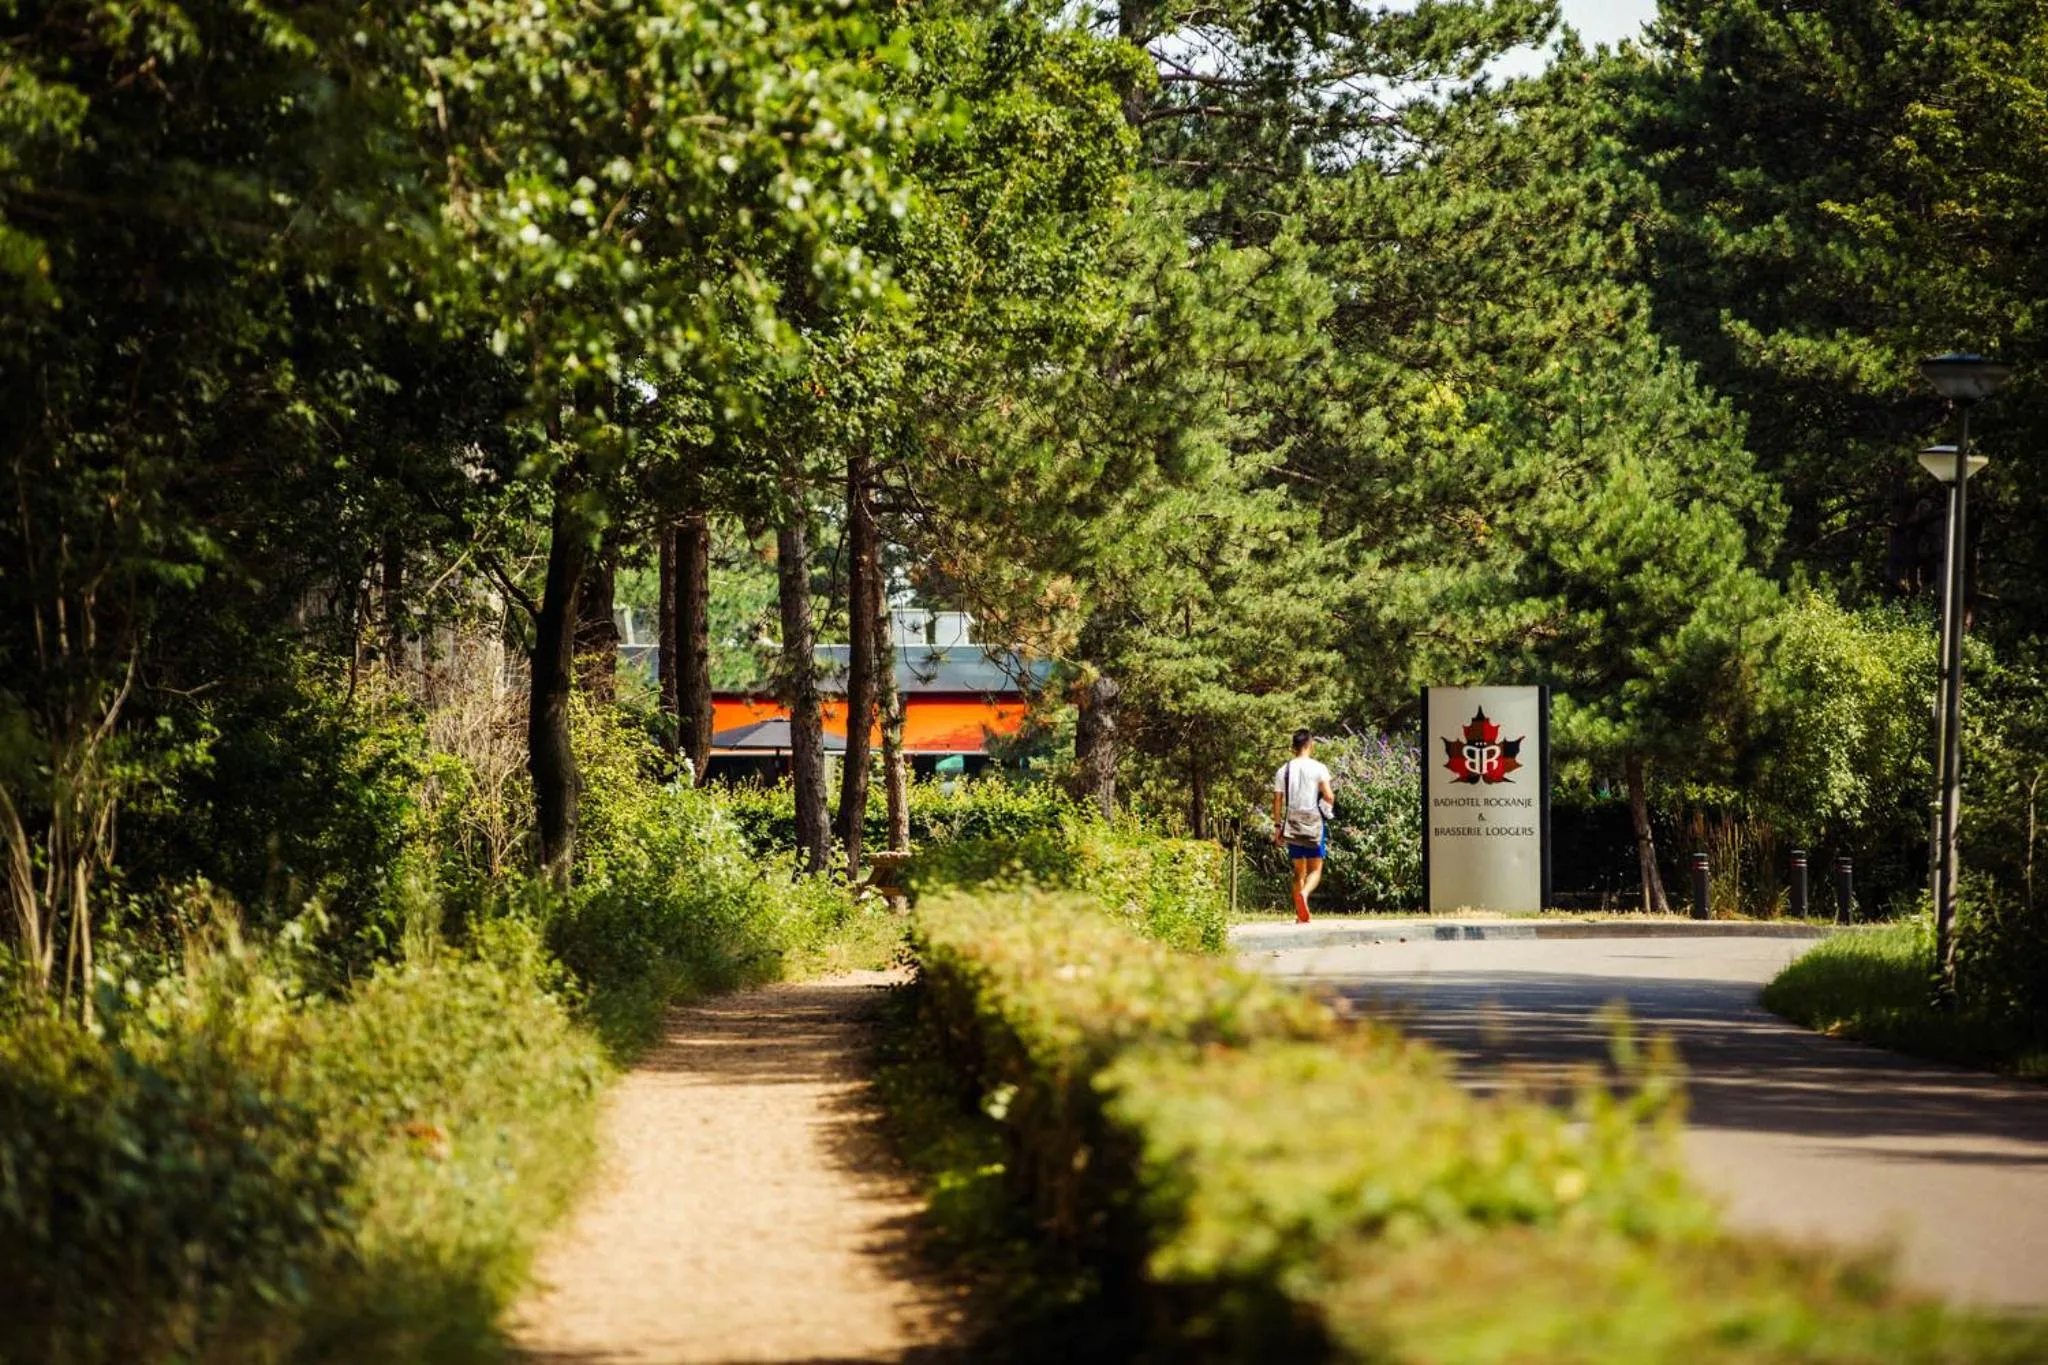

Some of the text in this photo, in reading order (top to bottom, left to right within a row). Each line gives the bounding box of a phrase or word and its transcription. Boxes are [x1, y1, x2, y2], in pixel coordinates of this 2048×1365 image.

[1433, 798, 1532, 808] BADHOTEL ROCKANJE
[1478, 812, 1486, 821] &
[1434, 827, 1534, 836] BRASSERIE LODGERS
